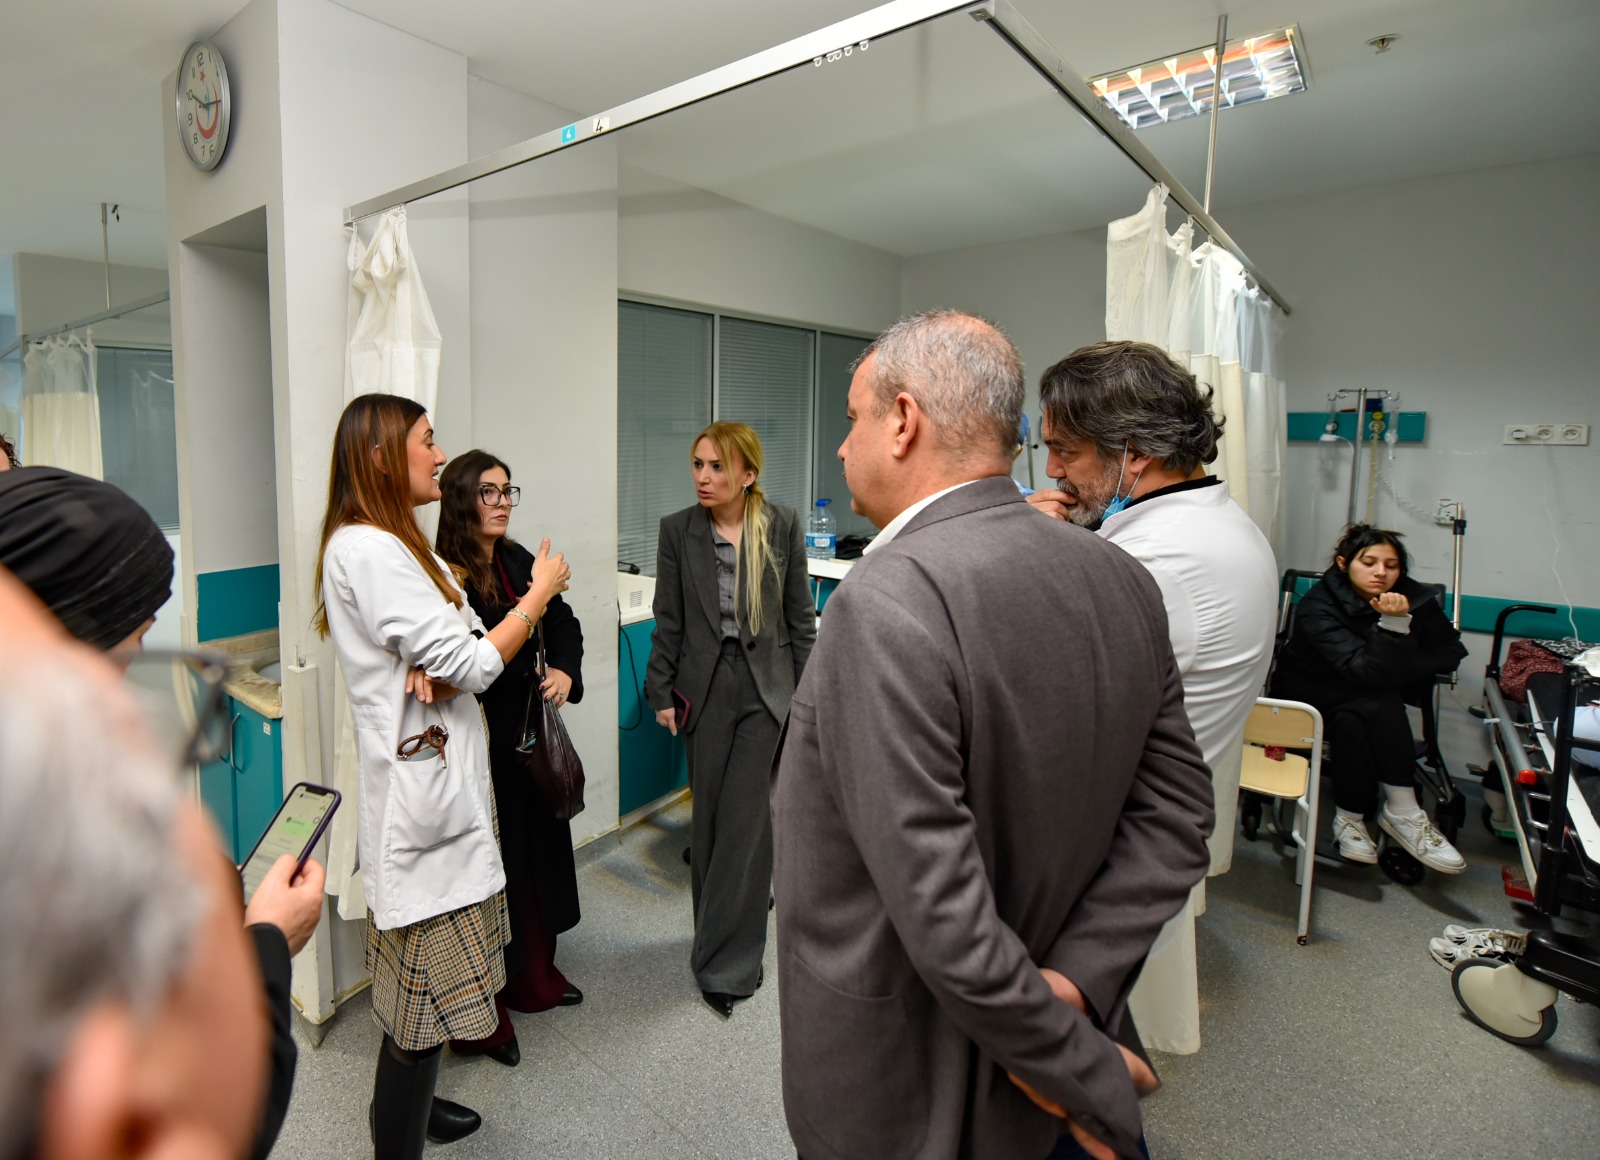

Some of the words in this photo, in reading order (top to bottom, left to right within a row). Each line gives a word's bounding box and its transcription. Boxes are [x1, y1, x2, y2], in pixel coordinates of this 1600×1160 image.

[197, 51, 204, 68] 12
[187, 112, 193, 126] 9
[595, 119, 603, 132] 4
[193, 133, 199, 145] 8
[200, 145, 206, 158] 7
